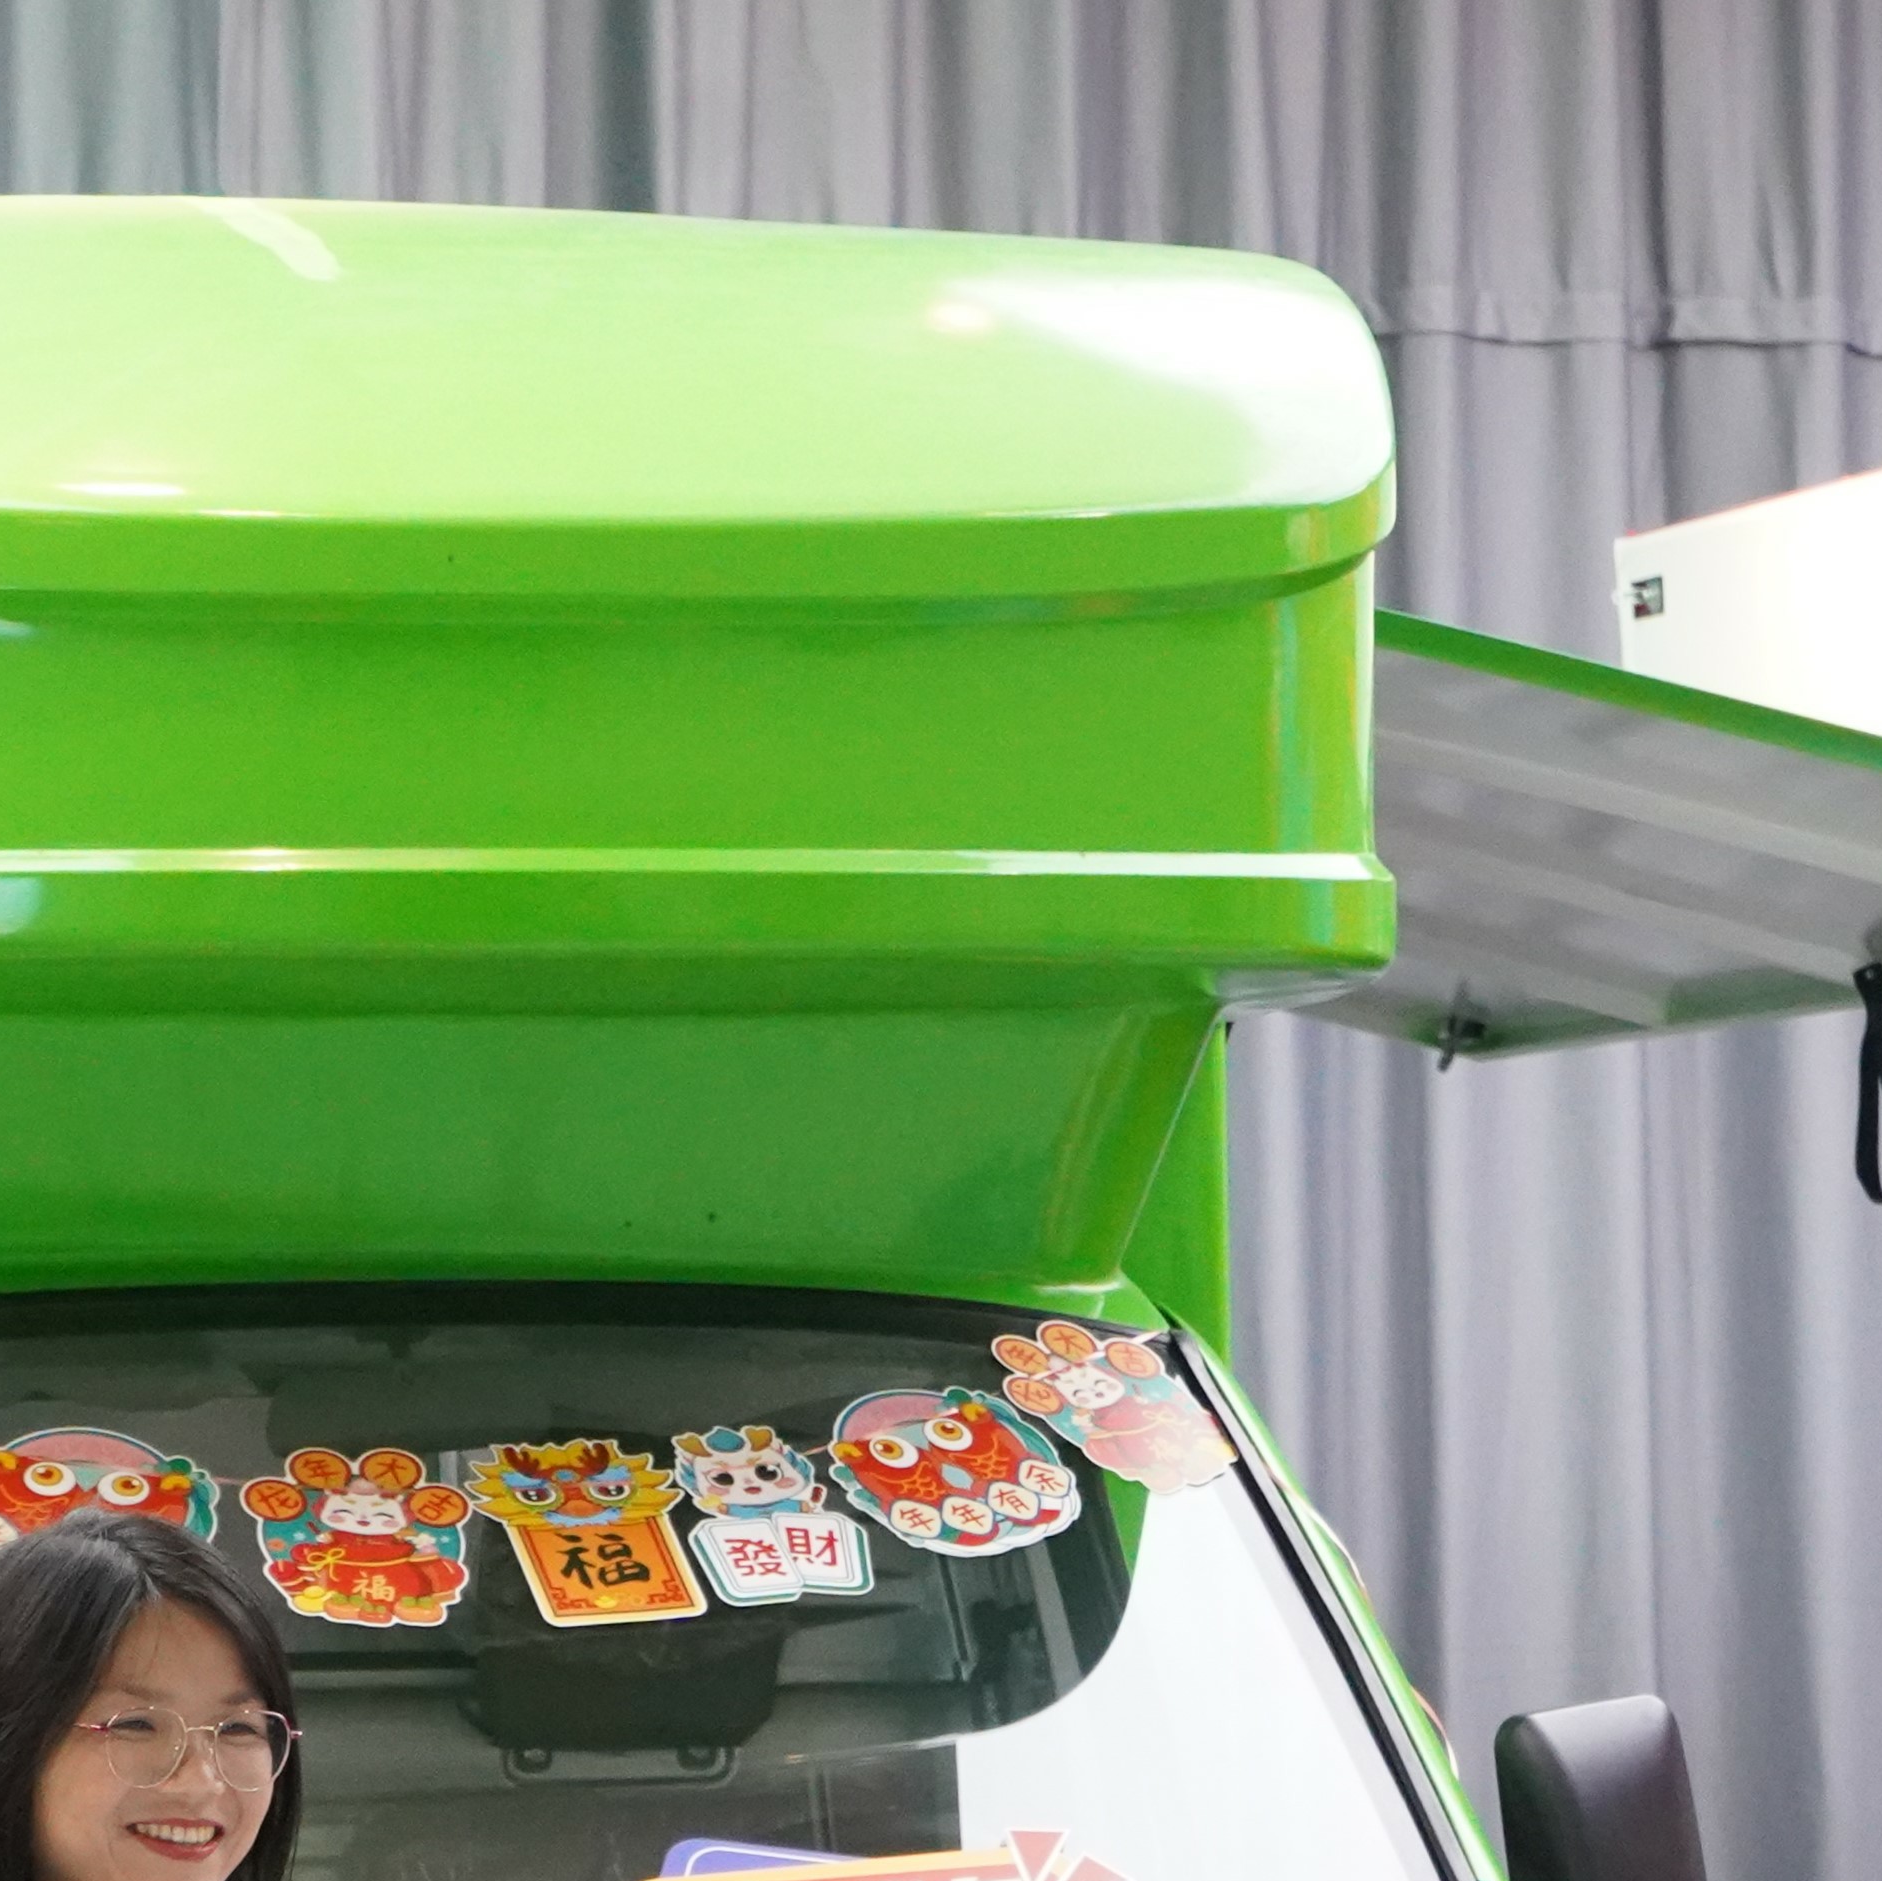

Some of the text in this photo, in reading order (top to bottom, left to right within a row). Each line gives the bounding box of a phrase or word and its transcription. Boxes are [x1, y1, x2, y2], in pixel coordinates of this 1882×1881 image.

[899, 1465, 1065, 1531] 年年有余
[554, 1532, 651, 1590] 福
[724, 1527, 839, 1577] 發財
